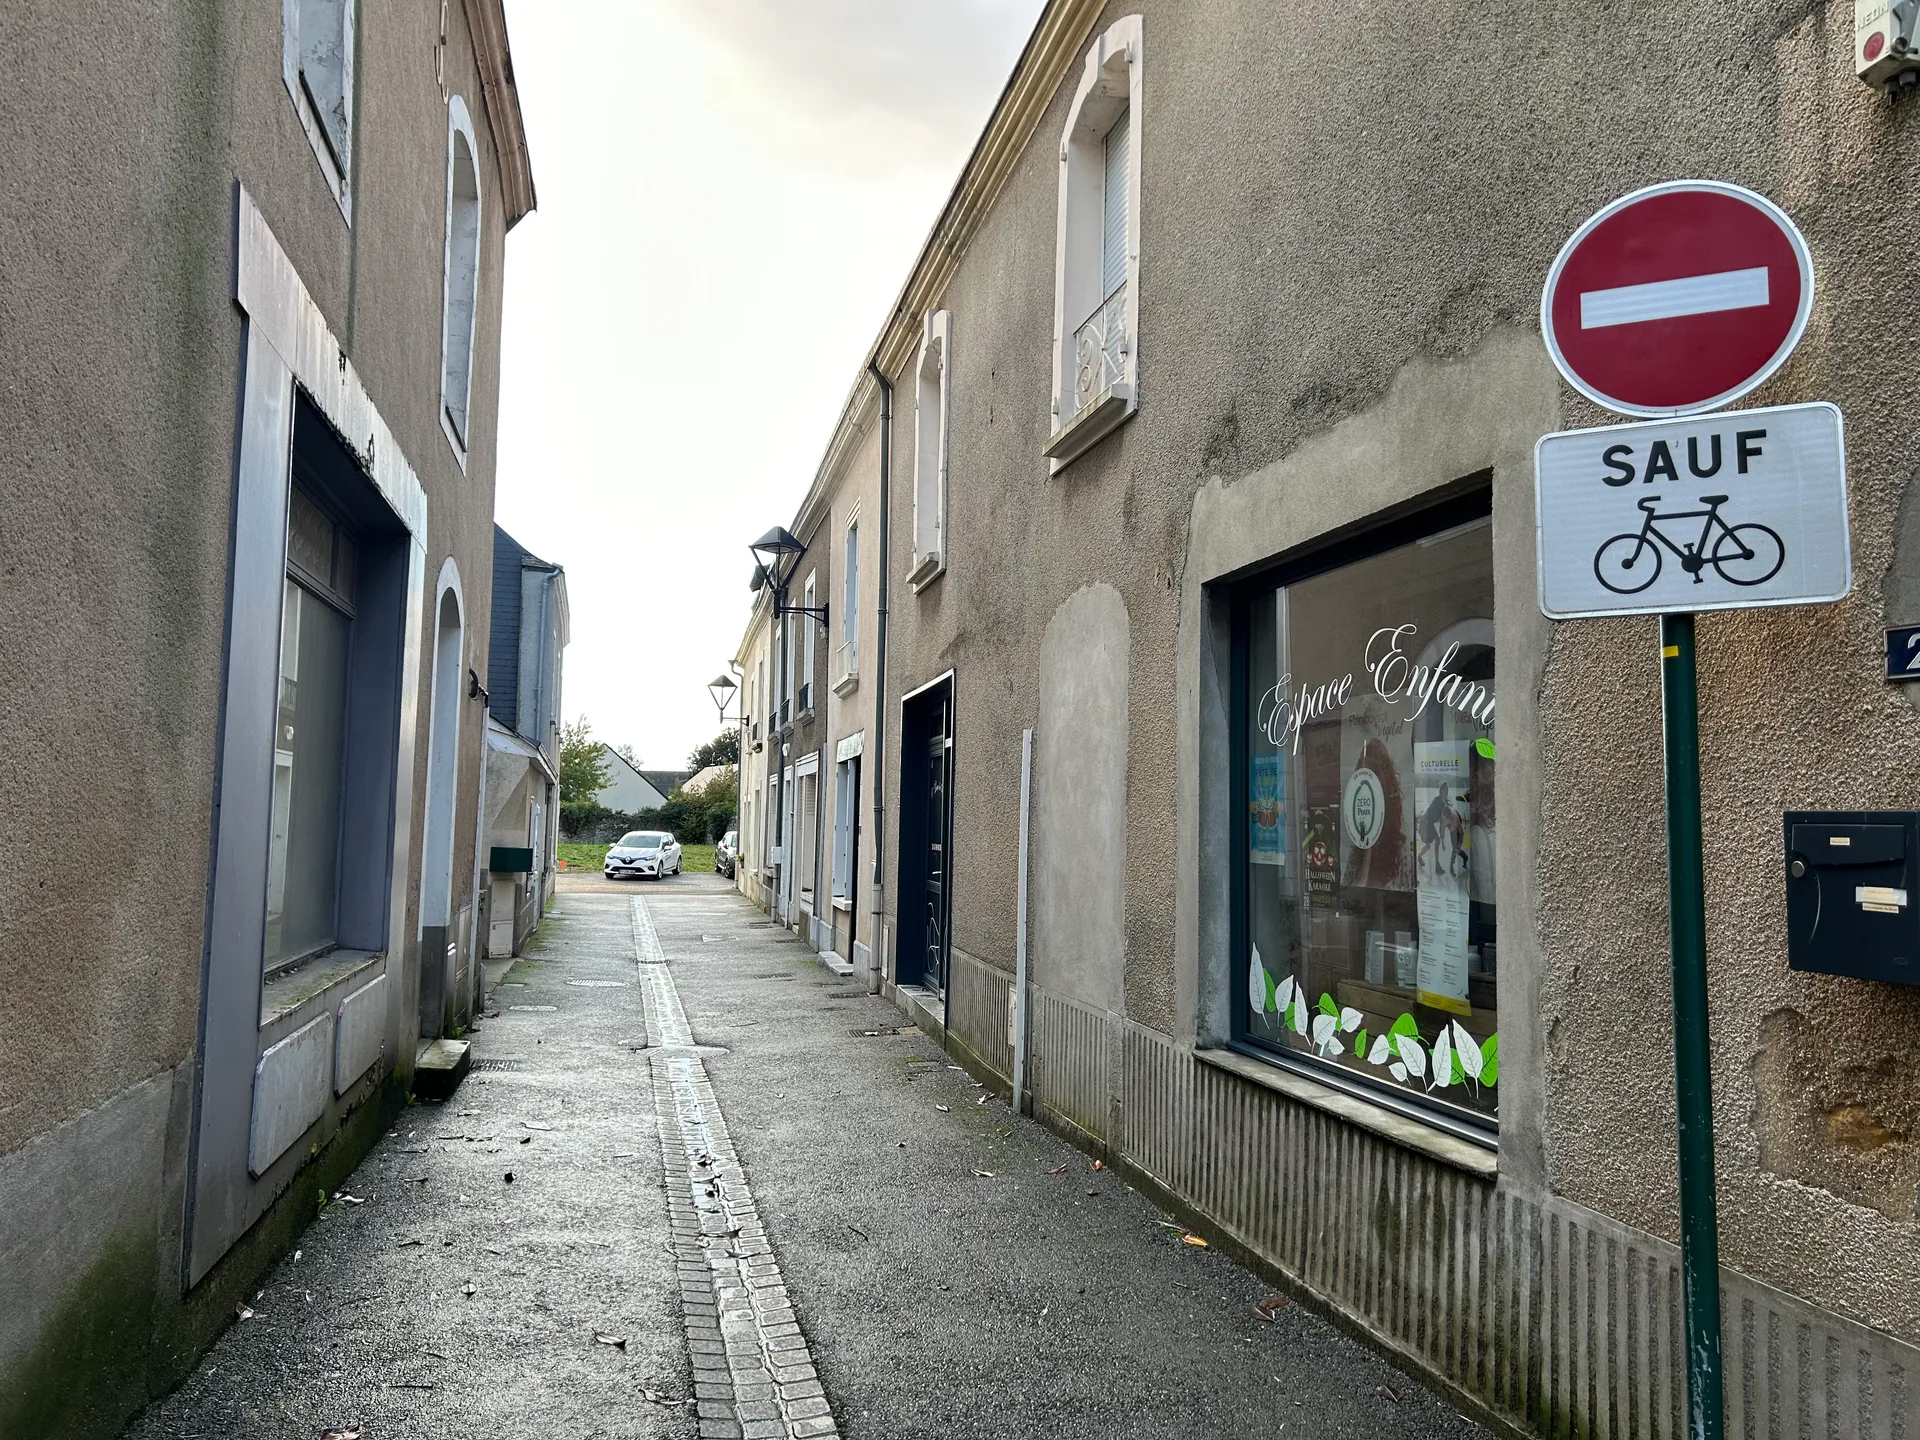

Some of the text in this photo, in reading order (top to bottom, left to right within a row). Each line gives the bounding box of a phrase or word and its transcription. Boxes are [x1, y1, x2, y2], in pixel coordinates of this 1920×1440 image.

[1602, 429, 1767, 487] SAUF
[1258, 673, 1354, 756] Espace
[1420, 760, 1459, 768] CULTURELLE
[1305, 868, 1336, 883] HALLOWEEN
